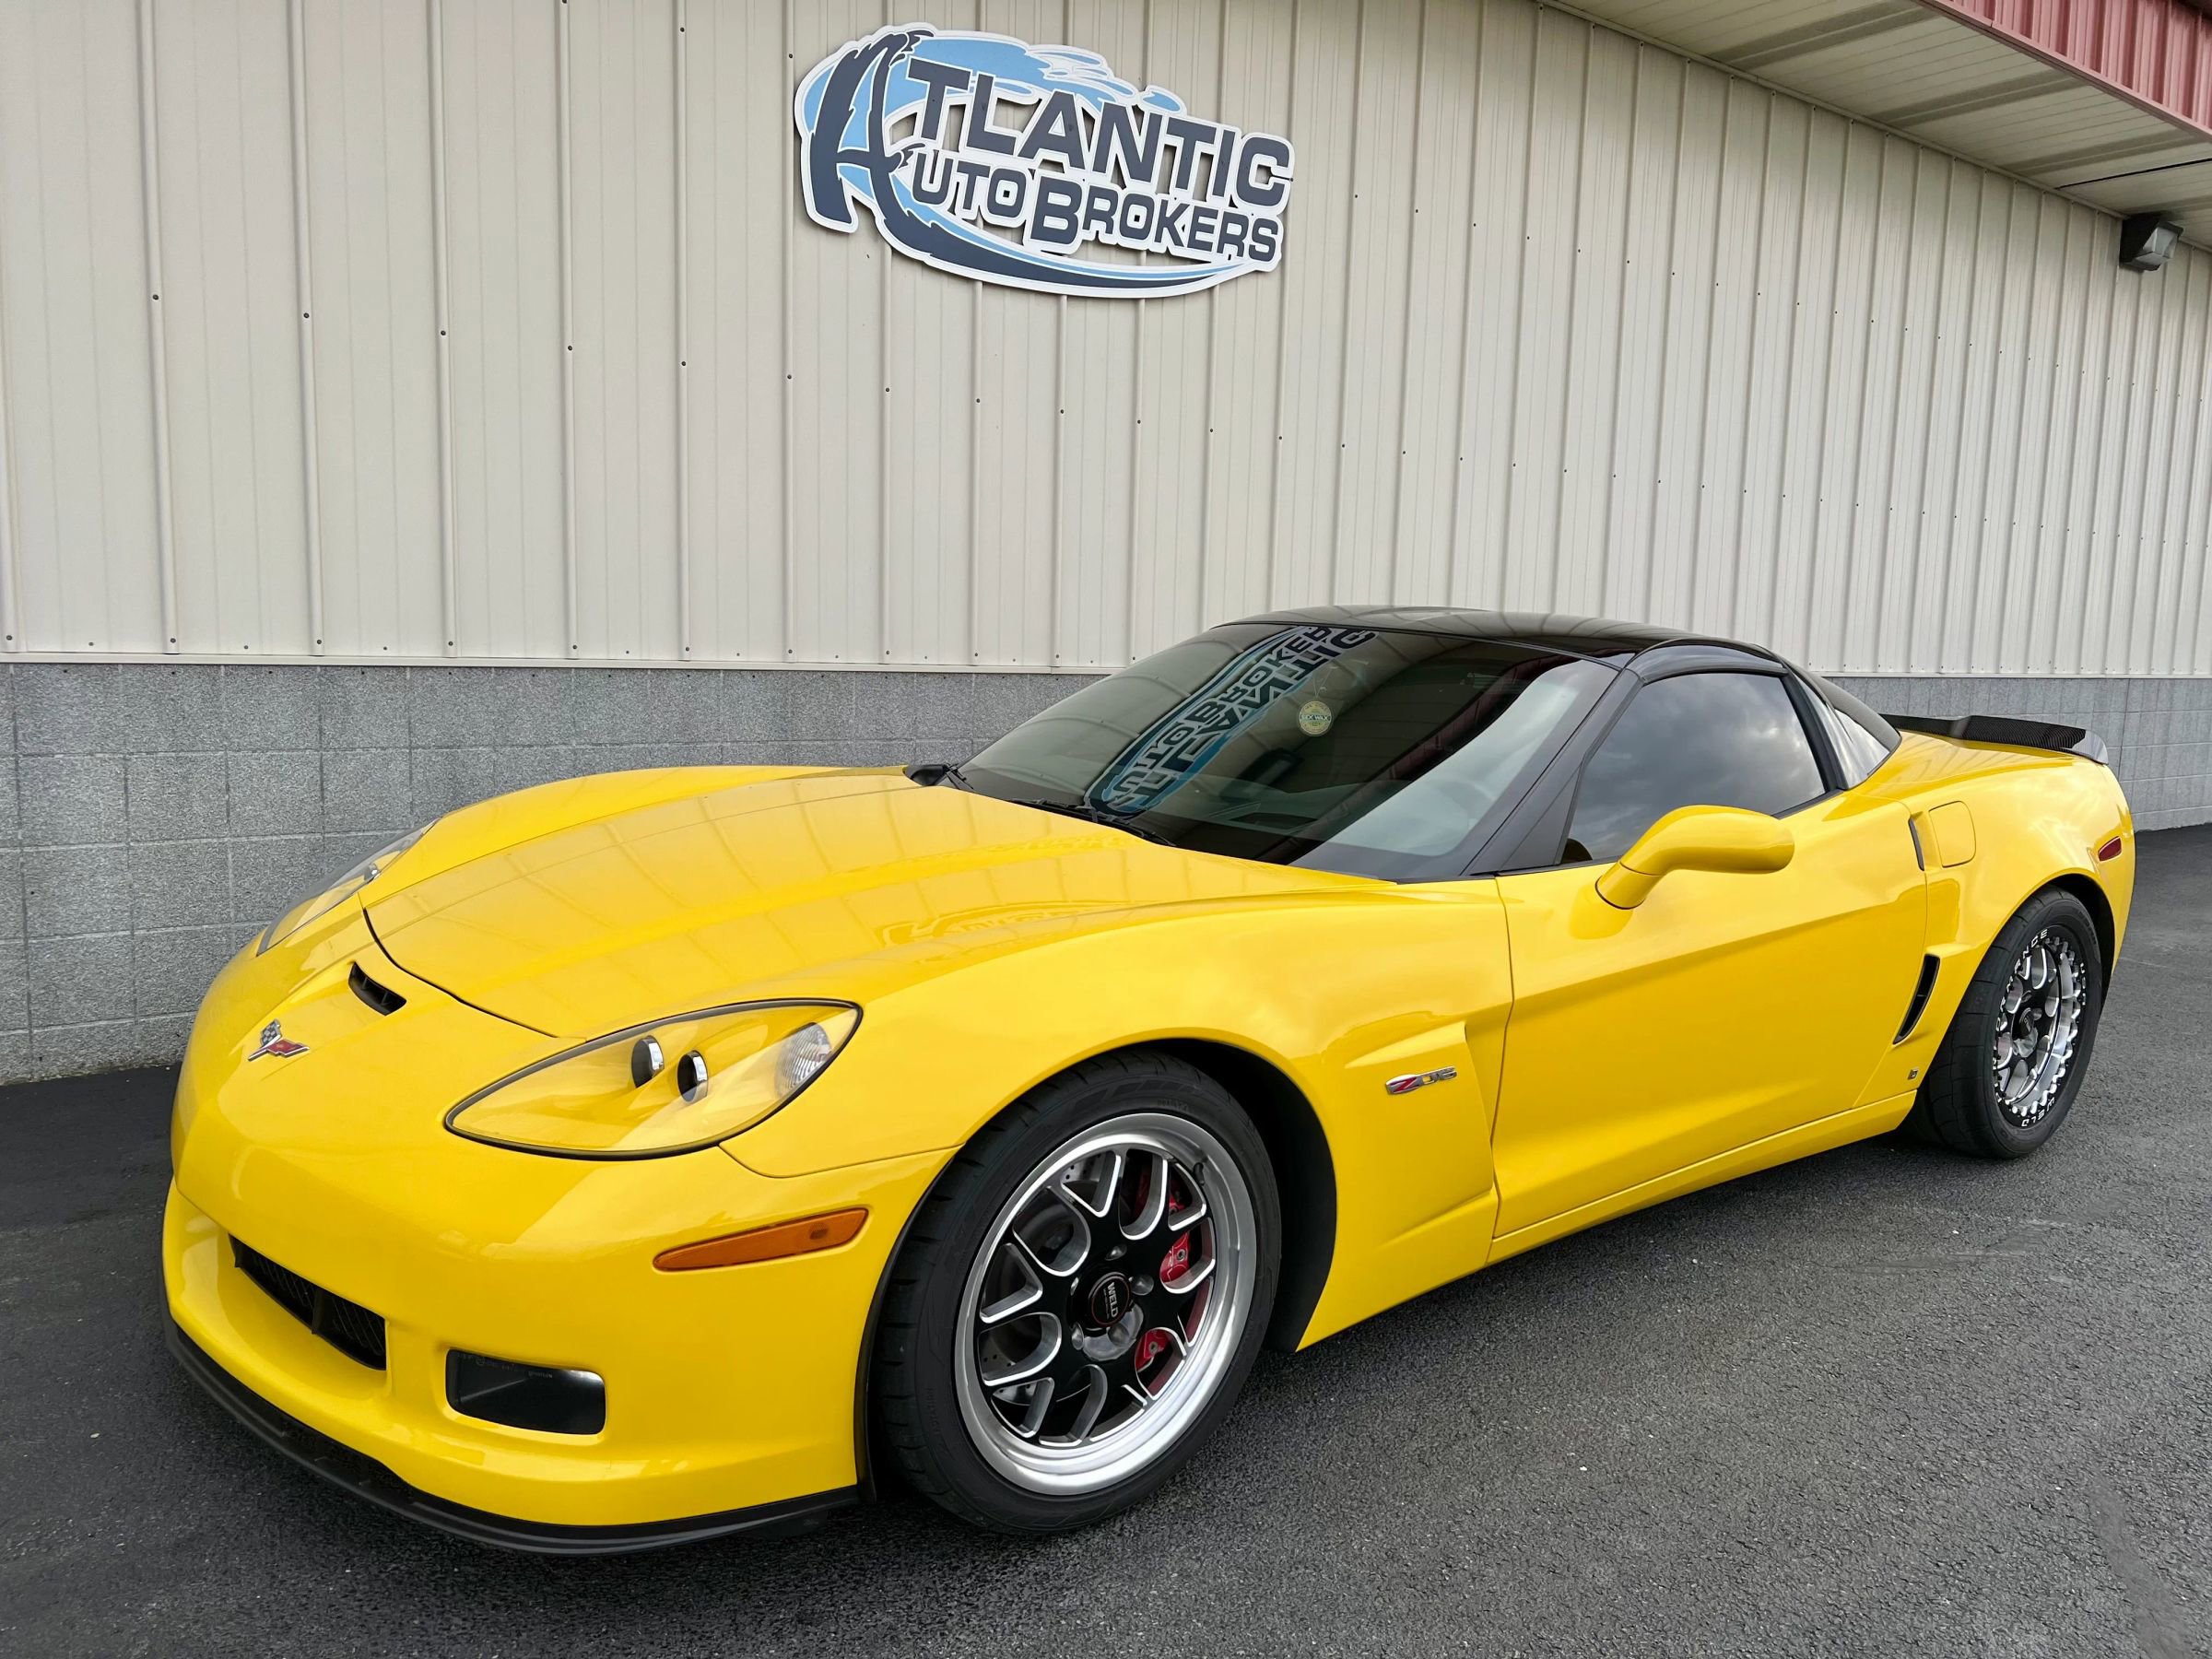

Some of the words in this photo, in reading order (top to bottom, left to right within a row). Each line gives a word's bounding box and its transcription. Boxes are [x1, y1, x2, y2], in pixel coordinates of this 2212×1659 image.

[809, 30, 1291, 224] ATLANTIC
[1030, 178, 1280, 263] BROKERS
[1107, 1281, 1119, 1318] WELD
